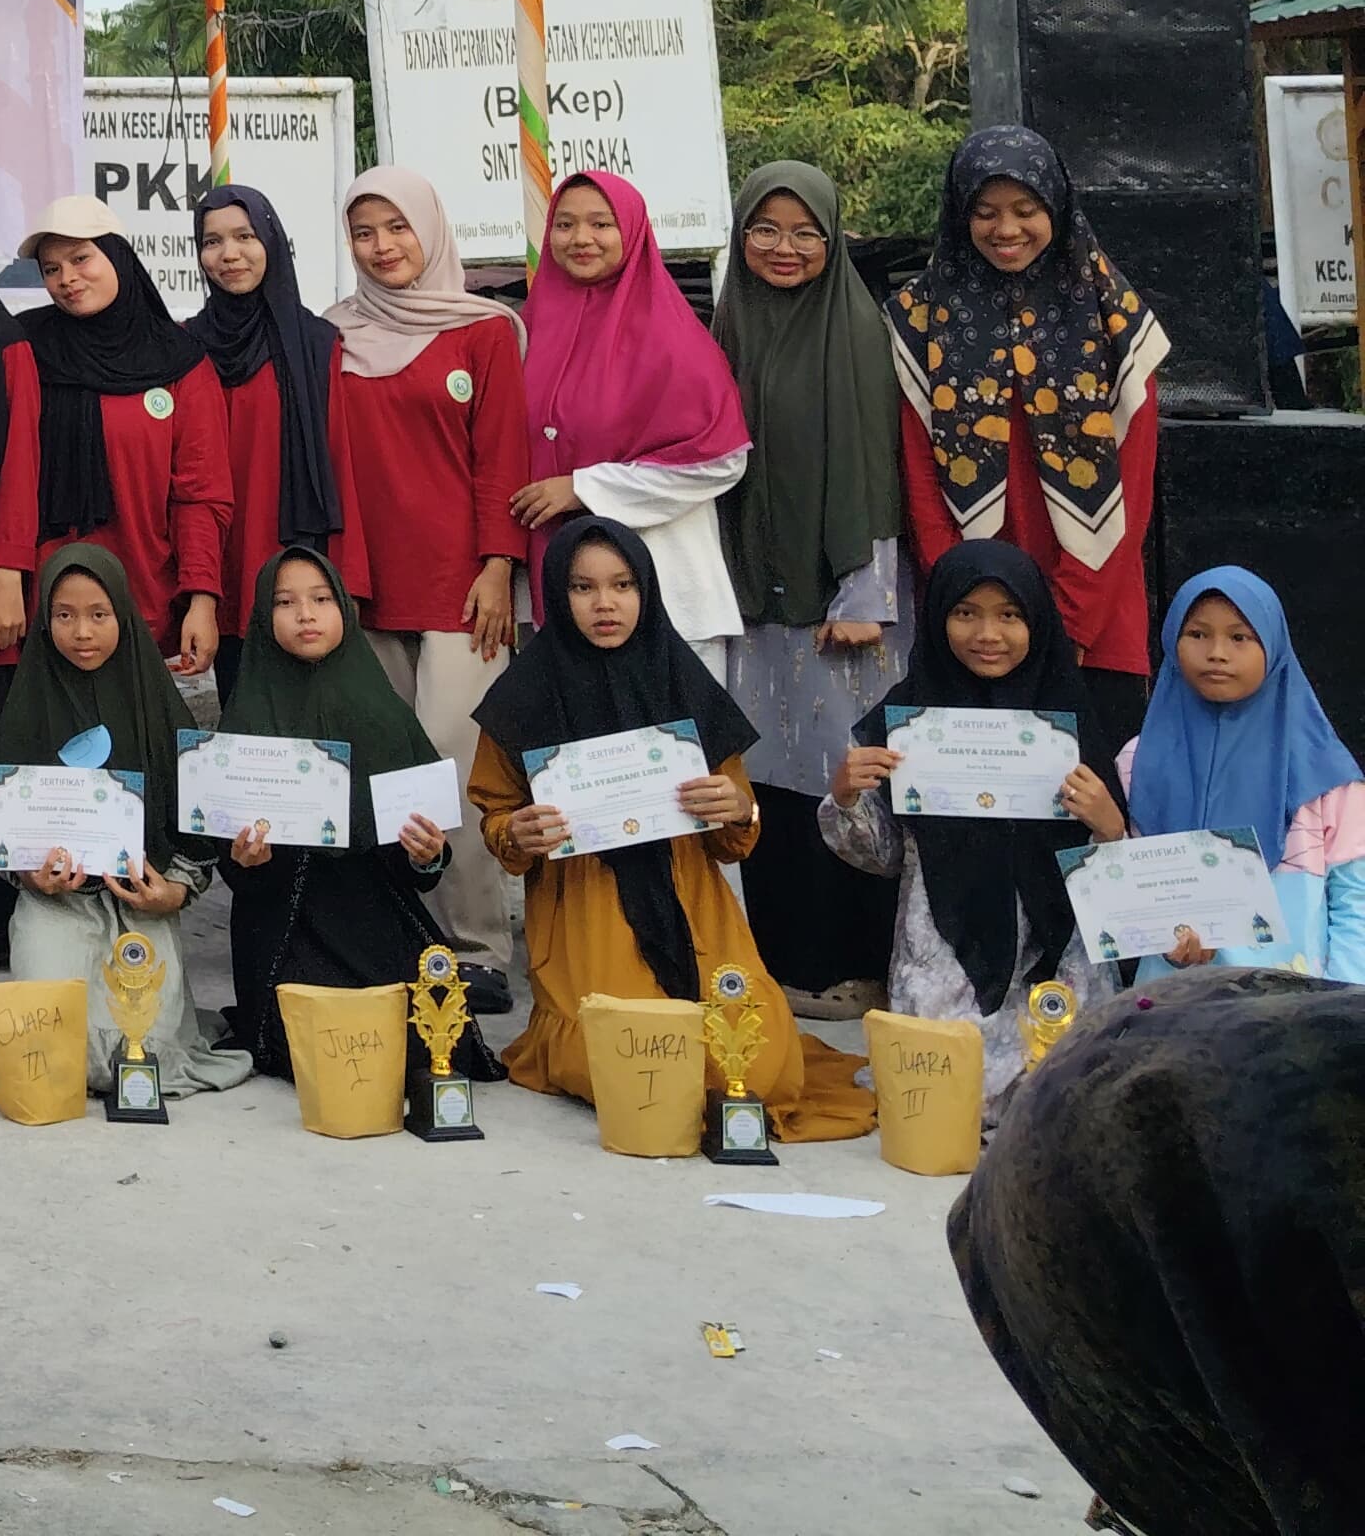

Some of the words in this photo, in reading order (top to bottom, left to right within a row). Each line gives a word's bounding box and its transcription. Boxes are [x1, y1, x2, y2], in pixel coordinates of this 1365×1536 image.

[403, 31, 448, 71] BADAN
[450, 22, 578, 68] PERMUSYAATAN
[580, 17, 684, 60] KEPENGHULUAN
[483, 79, 624, 128] (BKep)
[122, 112, 240, 141] KESEJAHTERN
[244, 113, 319, 142] KELUARGA
[482, 142, 557, 182] SINTG
[562, 137, 634, 177] PUSAKA
[94, 161, 213, 211] PKK
[455, 223, 478, 240] Hijau
[479, 221, 514, 240] Sintong
[161, 234, 196, 258] SINT
[1315, 259, 1353, 282] KEC.
[1320, 291, 1355, 304] Alama
[951, 719, 1009, 731] SERTIFIKAT
[236, 746, 289, 759] SERTIFIKAT
[586, 743, 637, 761] SERTIFIKAT
[39, 776, 85, 789] SERTIFIKAT
[1128, 845, 1189, 862] SERTIFIKAT
[317, 1027, 384, 1059] JUARA
[615, 1027, 689, 1061] JUARA
[890, 1041, 952, 1076] JUARA
